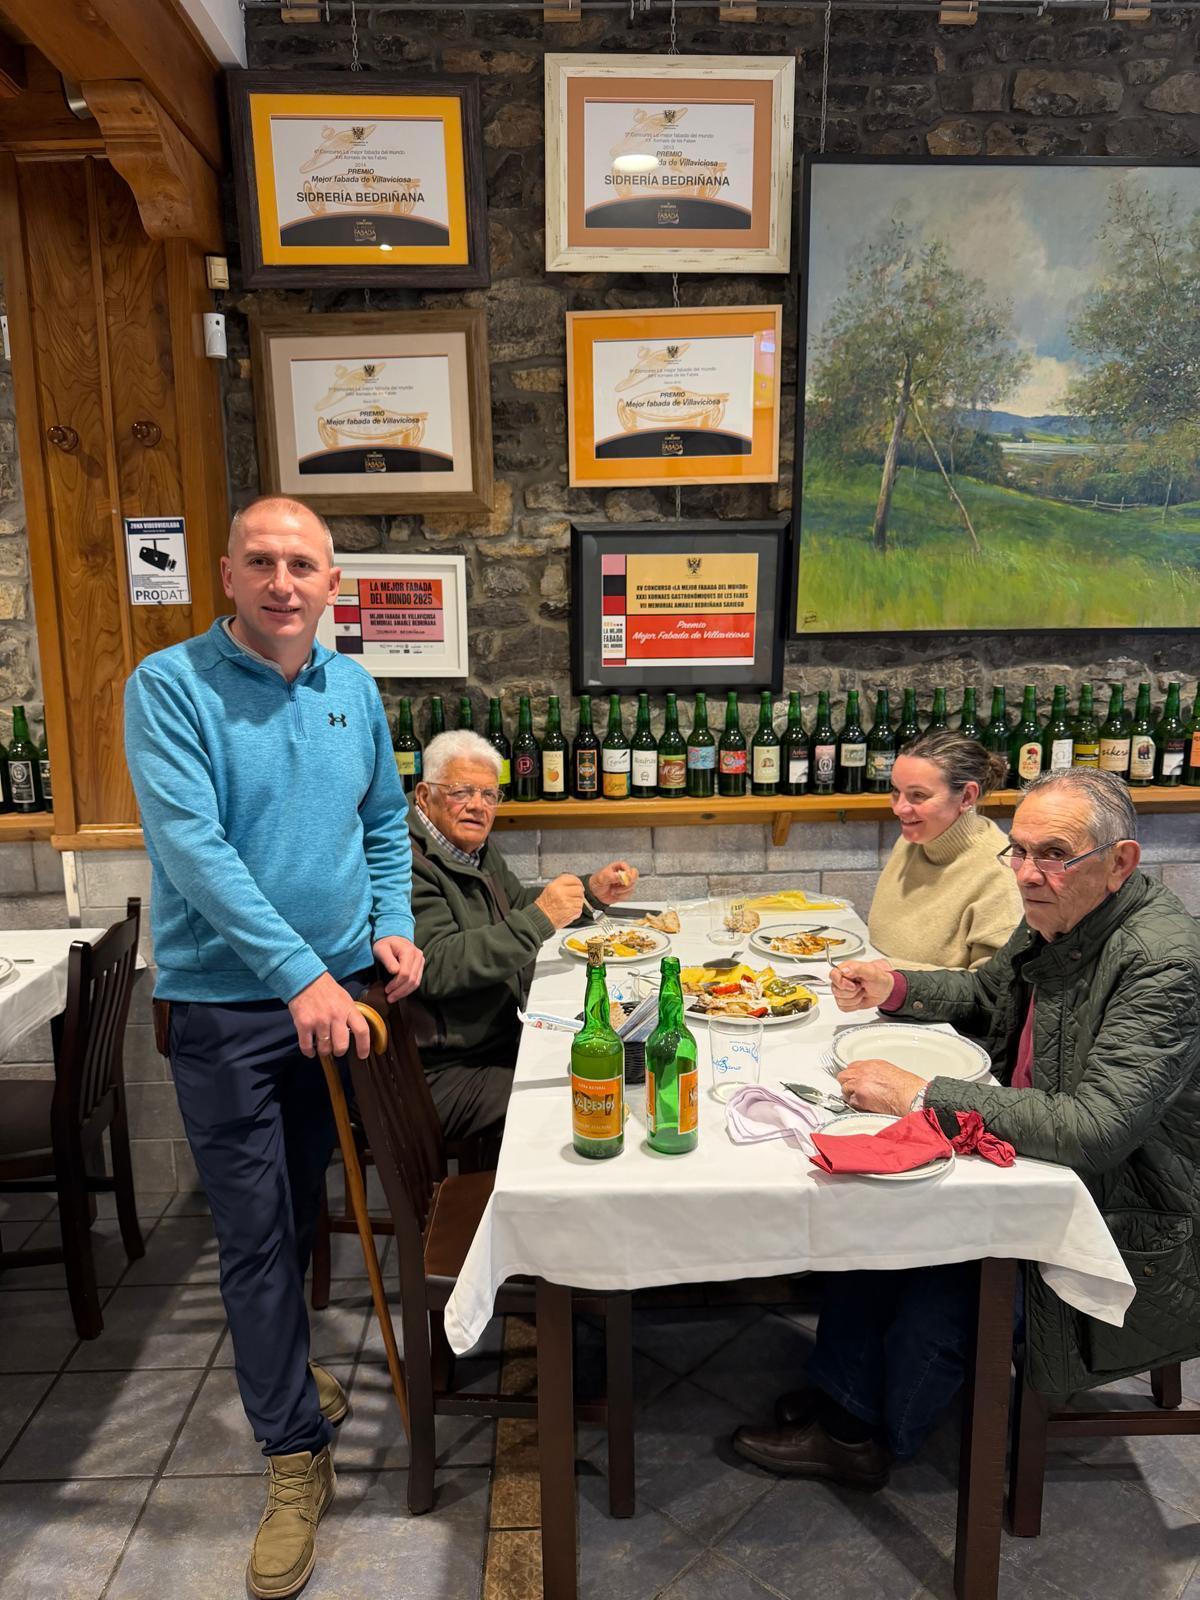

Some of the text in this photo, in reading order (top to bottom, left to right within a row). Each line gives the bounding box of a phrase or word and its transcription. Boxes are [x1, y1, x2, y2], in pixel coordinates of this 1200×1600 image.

[312, 176, 332, 184] Mejor
[604, 173, 730, 186] SIDRERÍA BEDRIÑANA
[296, 190, 425, 202] SIDRERÍA BEDRIÑANA
[327, 419, 345, 427] Mejor
[370, 582, 432, 591] LA MEJOR FABADA
[136, 590, 184, 600] PRODAT
[370, 593, 432, 604] DEL MUNDO 2025
[633, 632, 656, 644] Mejor
[658, 632, 688, 640] Fabada
[704, 631, 750, 639] Villaviciosa
